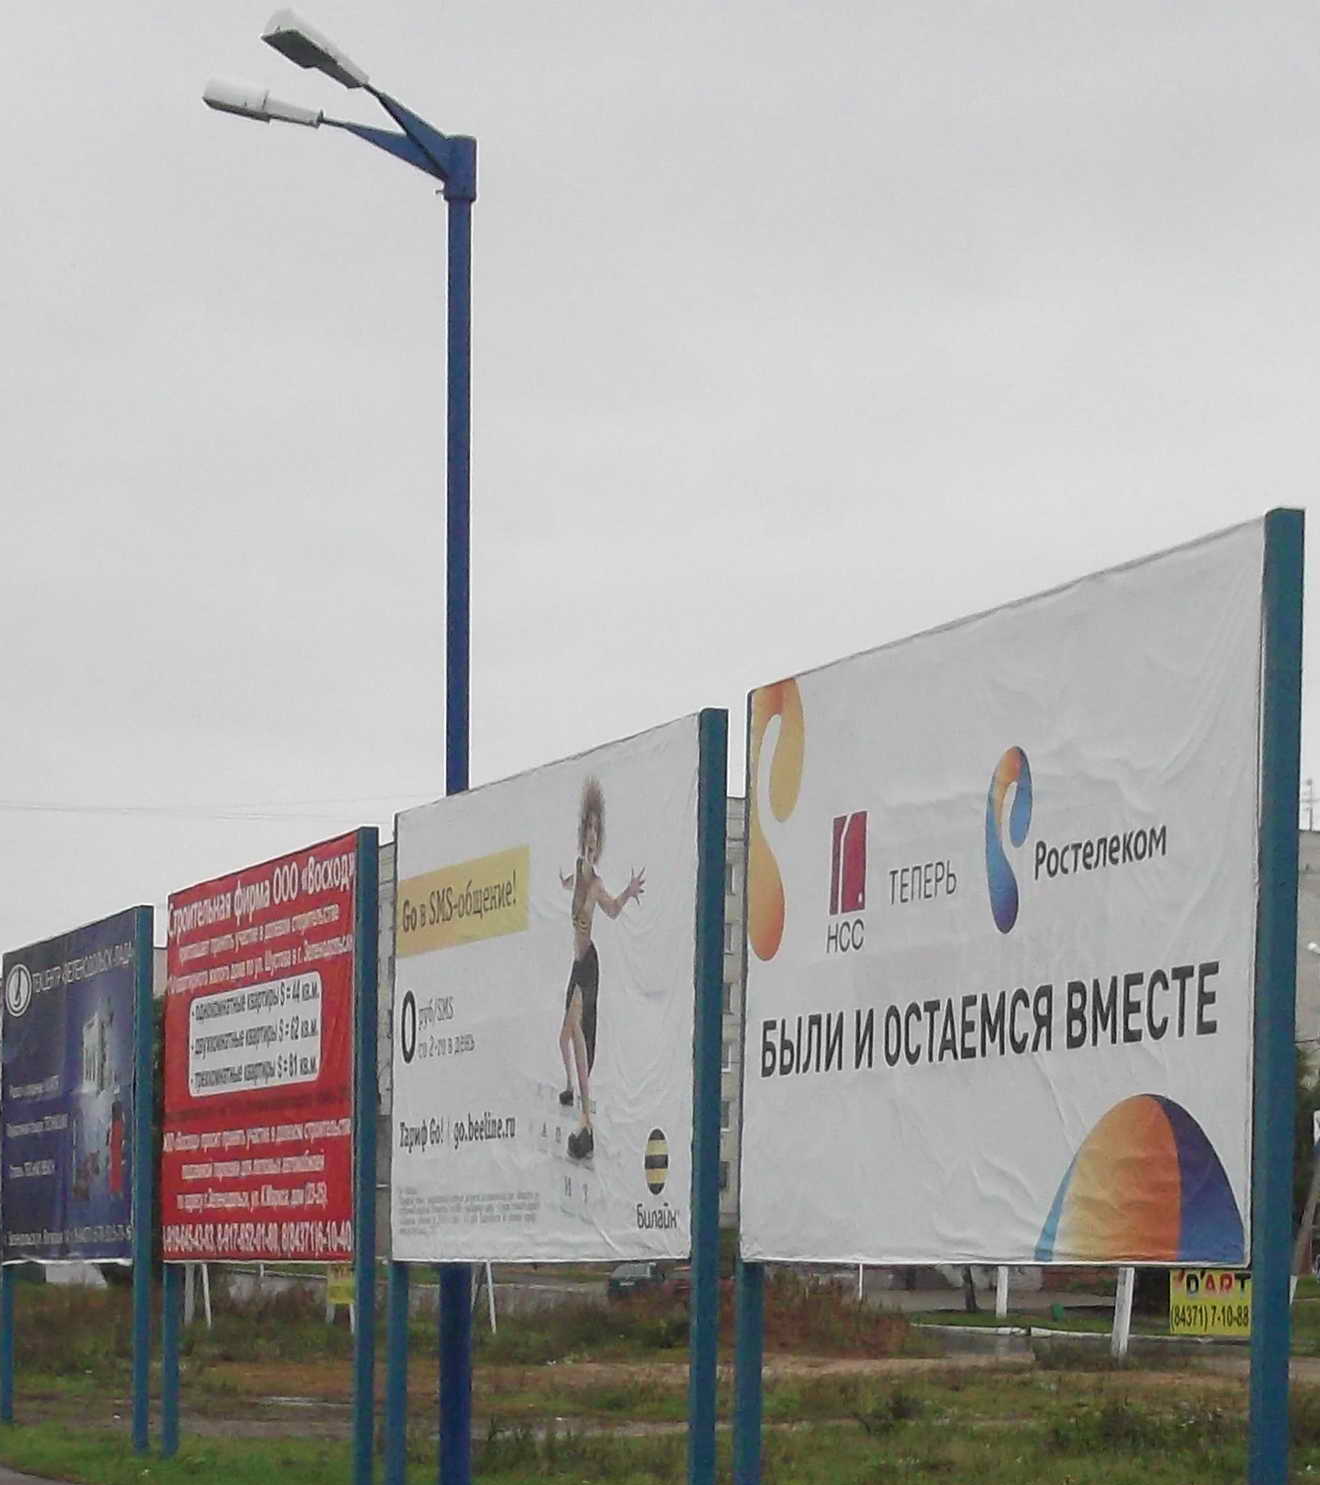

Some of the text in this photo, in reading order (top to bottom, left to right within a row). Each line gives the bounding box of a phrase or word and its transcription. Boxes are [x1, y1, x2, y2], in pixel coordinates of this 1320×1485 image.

[888, 858, 959, 907] ТЕПЕРЬ
[1033, 825, 1169, 882] Ростелеком
[169, 892, 231, 944] Строительная
[234, 879, 270, 926] фирма
[272, 861, 299, 905] ООО
[402, 869, 517, 933] Go в SMS-общение!
[760, 960, 1221, 1079] БЫЛИ И ОСТАЕМСЯ ВМЕСТЕ
